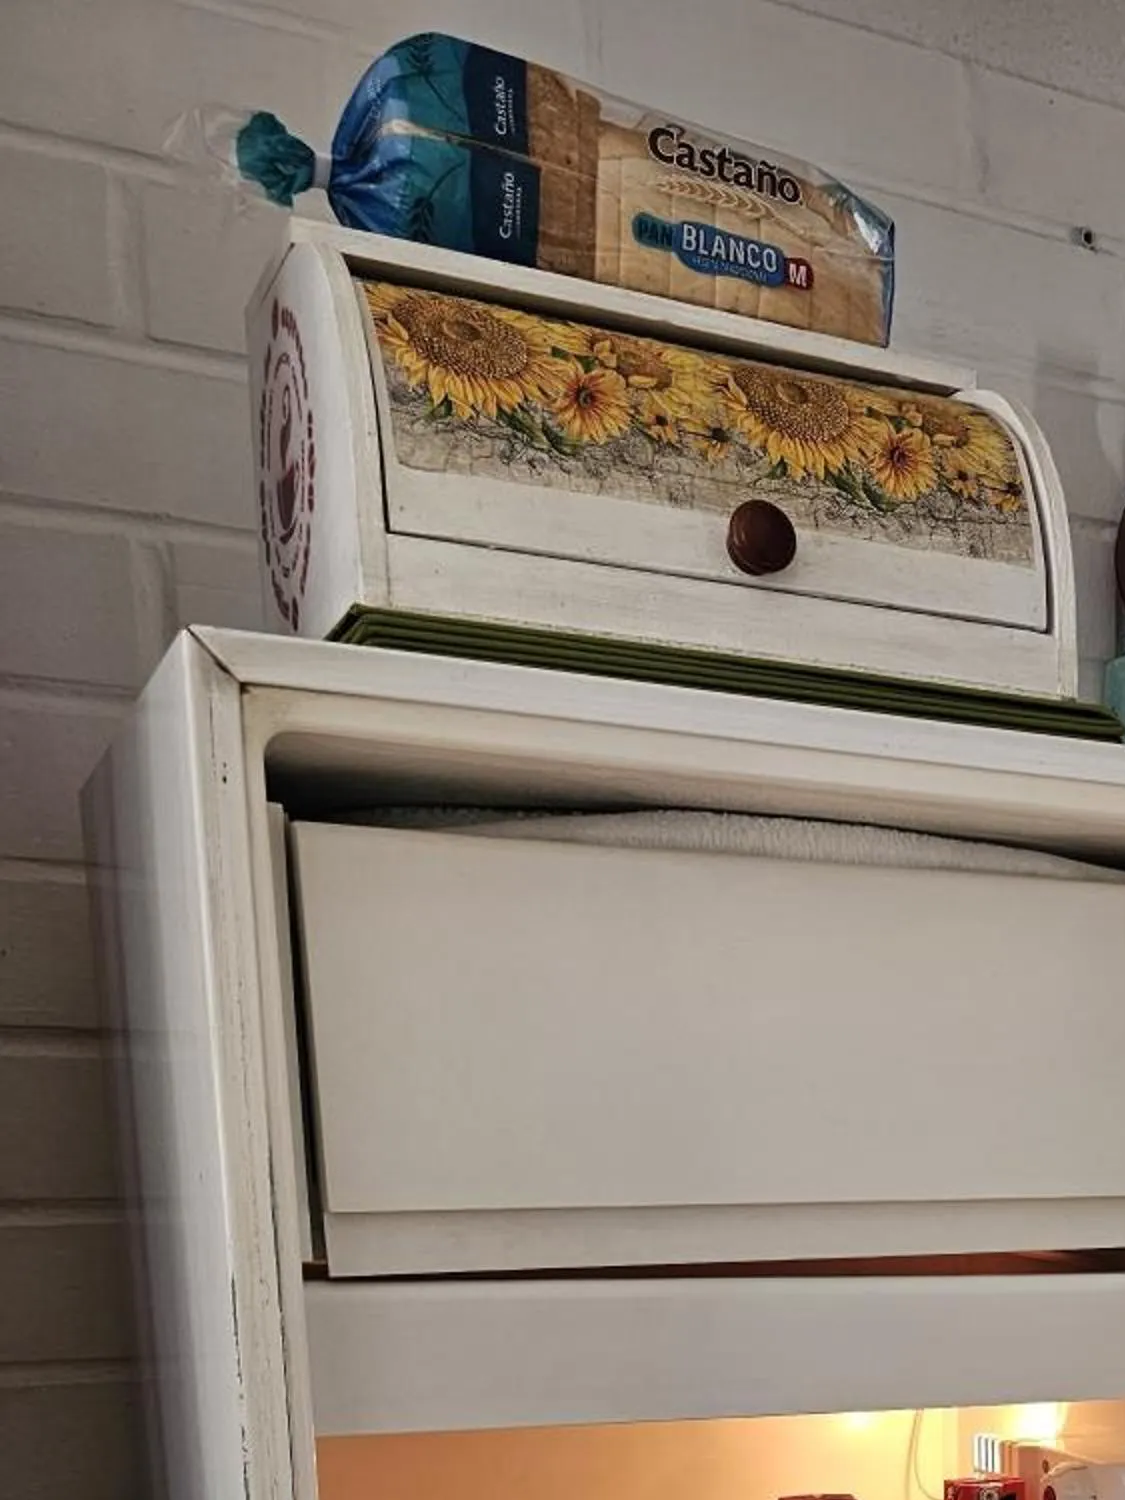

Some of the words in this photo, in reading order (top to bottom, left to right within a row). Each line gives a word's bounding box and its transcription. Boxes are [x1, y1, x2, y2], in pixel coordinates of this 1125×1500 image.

[648, 124, 803, 206] Castaño
[682, 222, 777, 273] BLANCO
[788, 262, 807, 288] M
